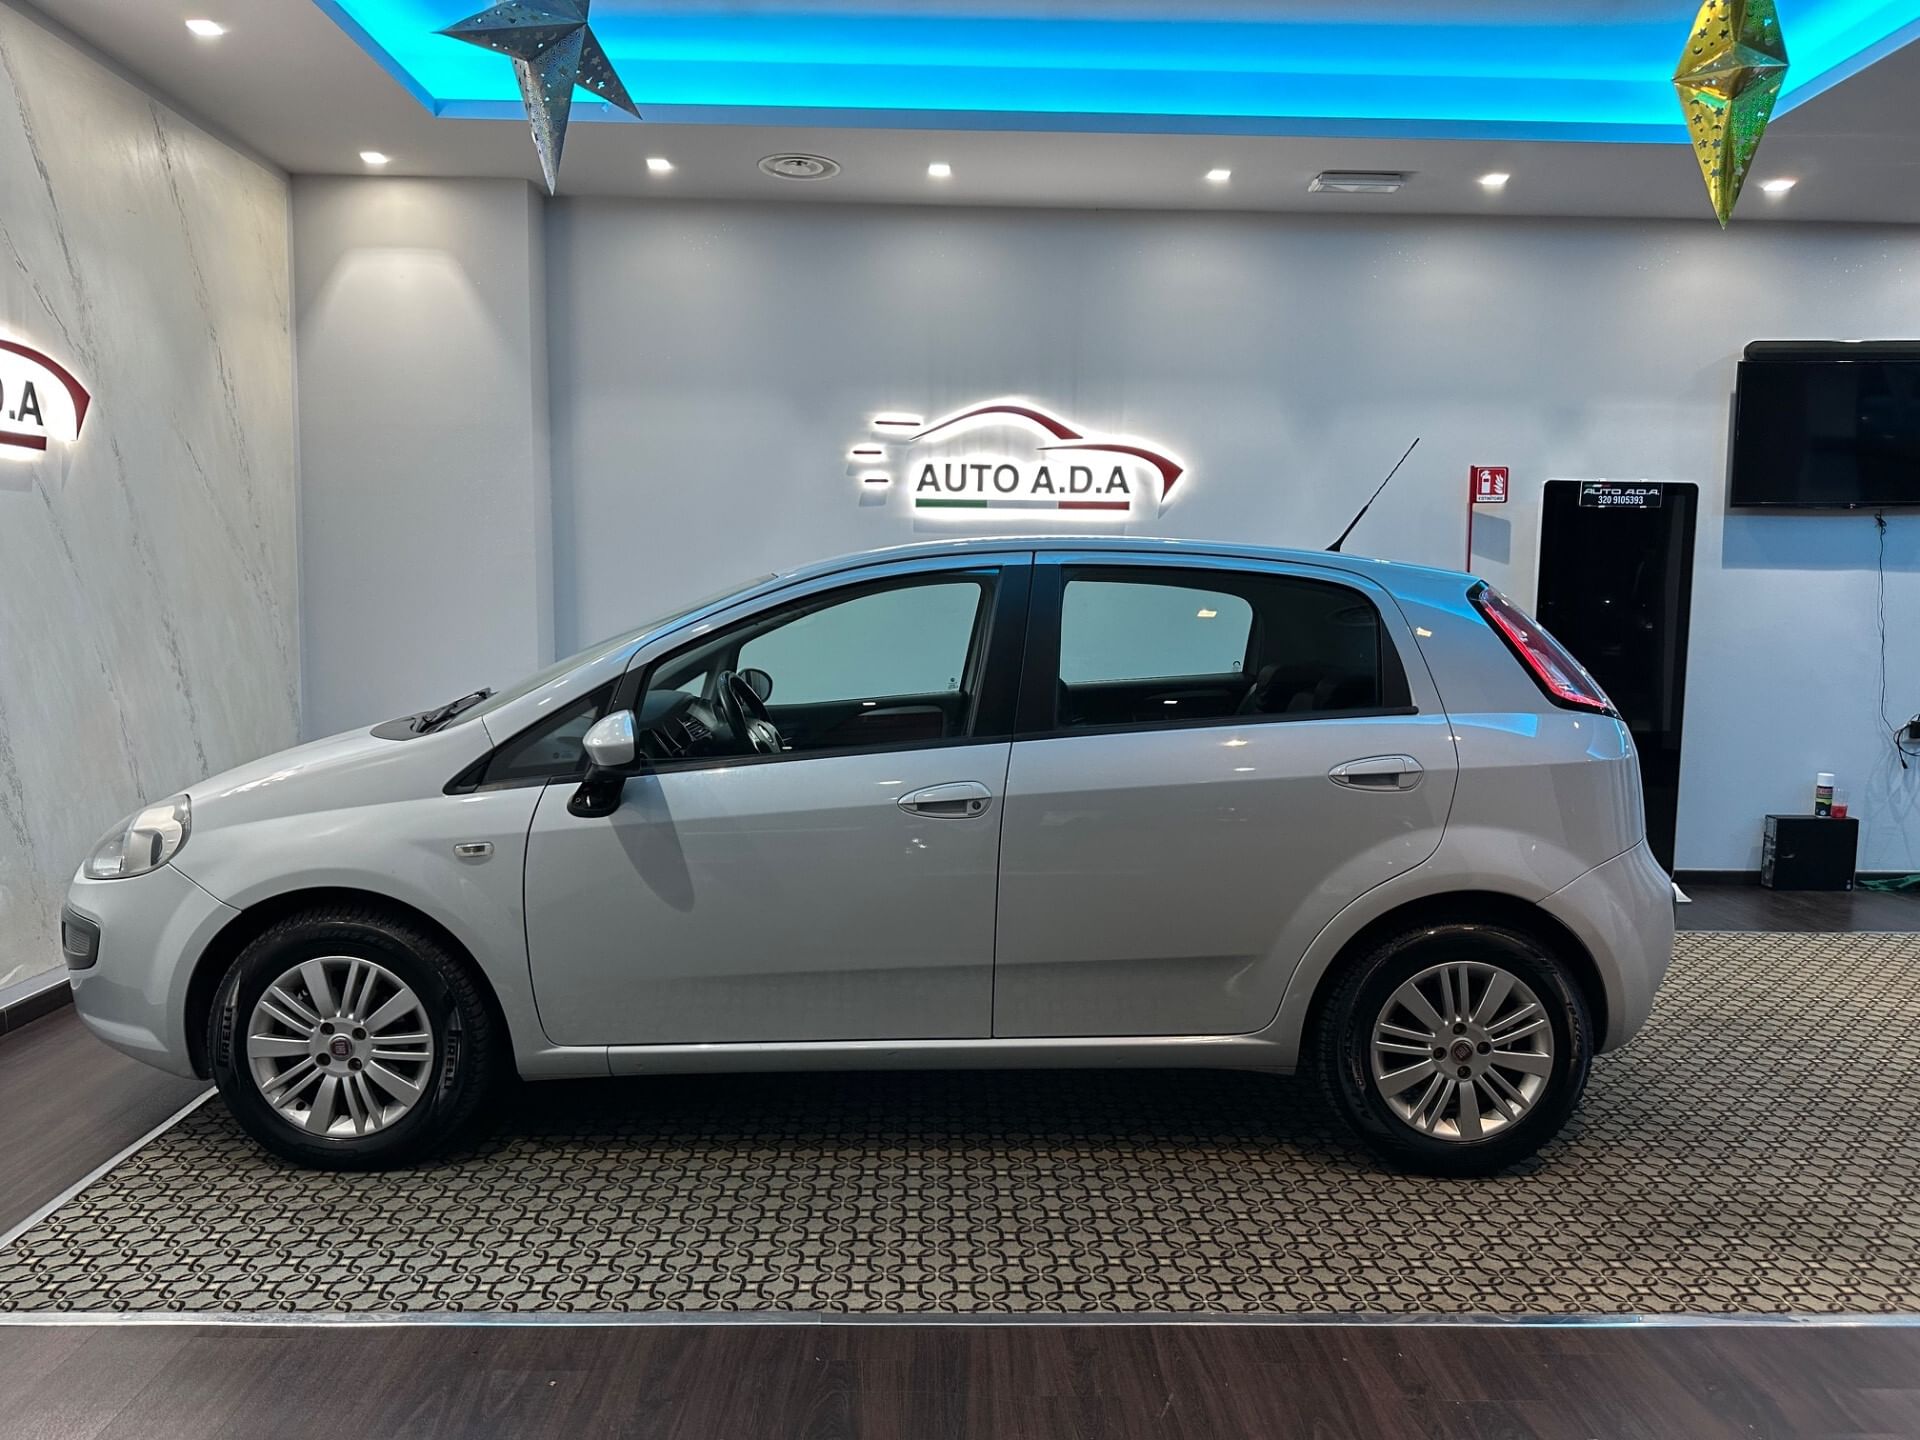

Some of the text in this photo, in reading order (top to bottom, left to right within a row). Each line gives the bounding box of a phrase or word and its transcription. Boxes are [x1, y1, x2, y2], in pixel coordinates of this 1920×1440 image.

[0, 378, 44, 426] .A
[916, 463, 1130, 494] AUTO A.D.A
[1597, 495, 1644, 505] 320 9105393
